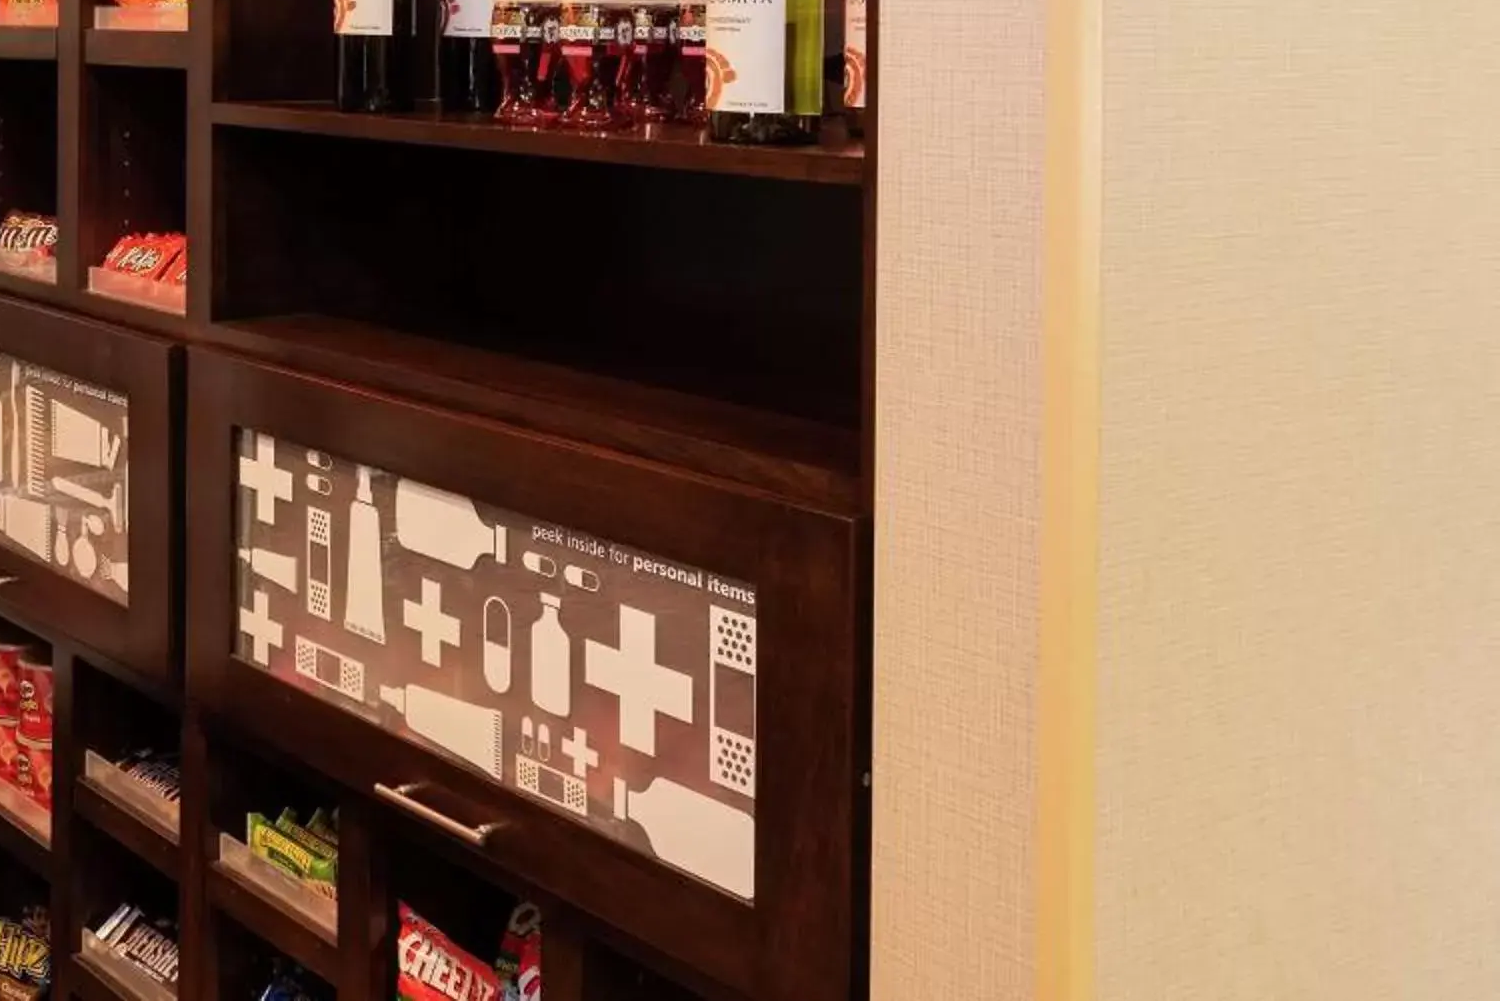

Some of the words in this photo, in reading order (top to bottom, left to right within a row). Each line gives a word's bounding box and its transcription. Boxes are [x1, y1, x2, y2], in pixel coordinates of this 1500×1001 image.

[531, 525, 564, 545] peek
[567, 533, 606, 558] inside
[608, 546, 630, 565] for
[632, 555, 702, 589] personal
[707, 574, 756, 605] items
